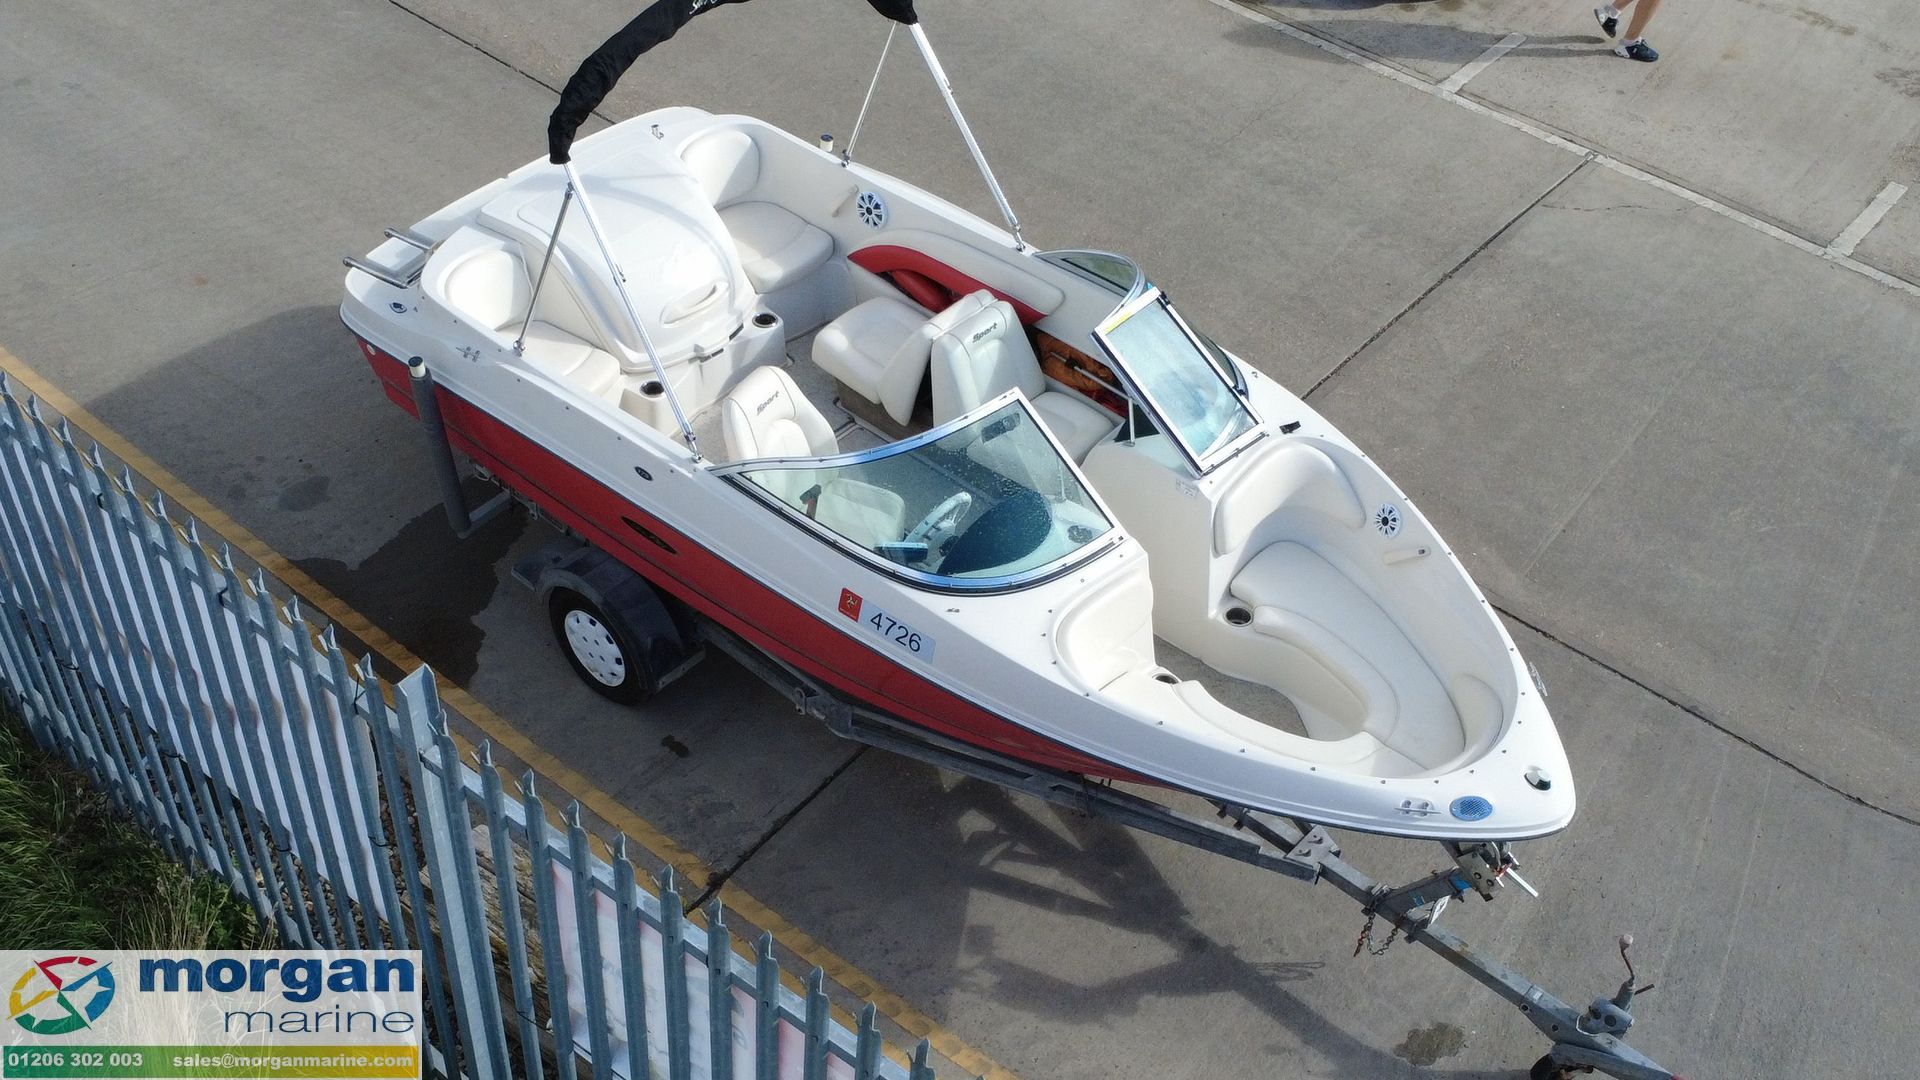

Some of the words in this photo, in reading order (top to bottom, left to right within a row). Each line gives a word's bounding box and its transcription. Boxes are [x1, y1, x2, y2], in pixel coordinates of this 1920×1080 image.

[972, 322, 998, 343] Sport
[756, 390, 779, 416] Sport
[870, 612, 922, 653] 4726
